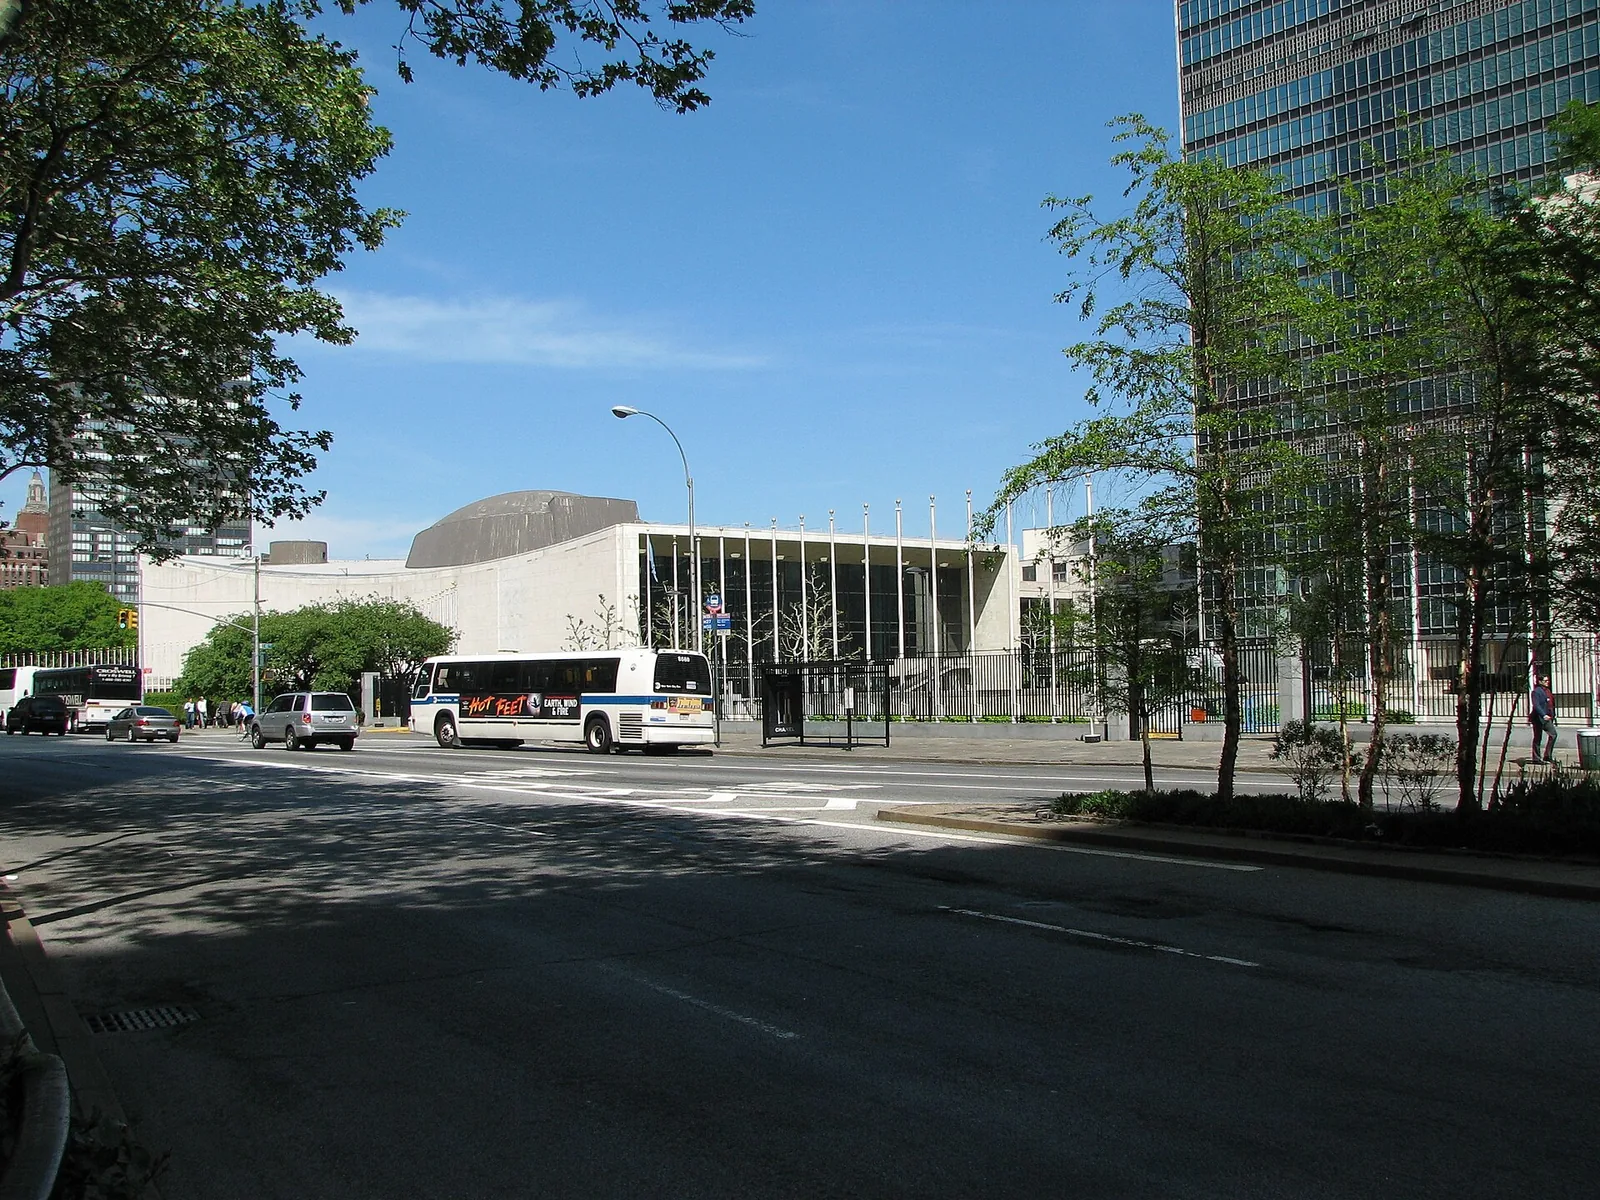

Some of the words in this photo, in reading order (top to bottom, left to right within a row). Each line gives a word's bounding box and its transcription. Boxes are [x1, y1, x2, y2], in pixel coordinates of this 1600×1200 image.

[468, 695, 495, 716] HOT
[496, 695, 527, 716] FEET
[563, 699, 578, 708] WIND
[551, 707, 556, 716] &
[556, 707, 569, 716] FIRE
